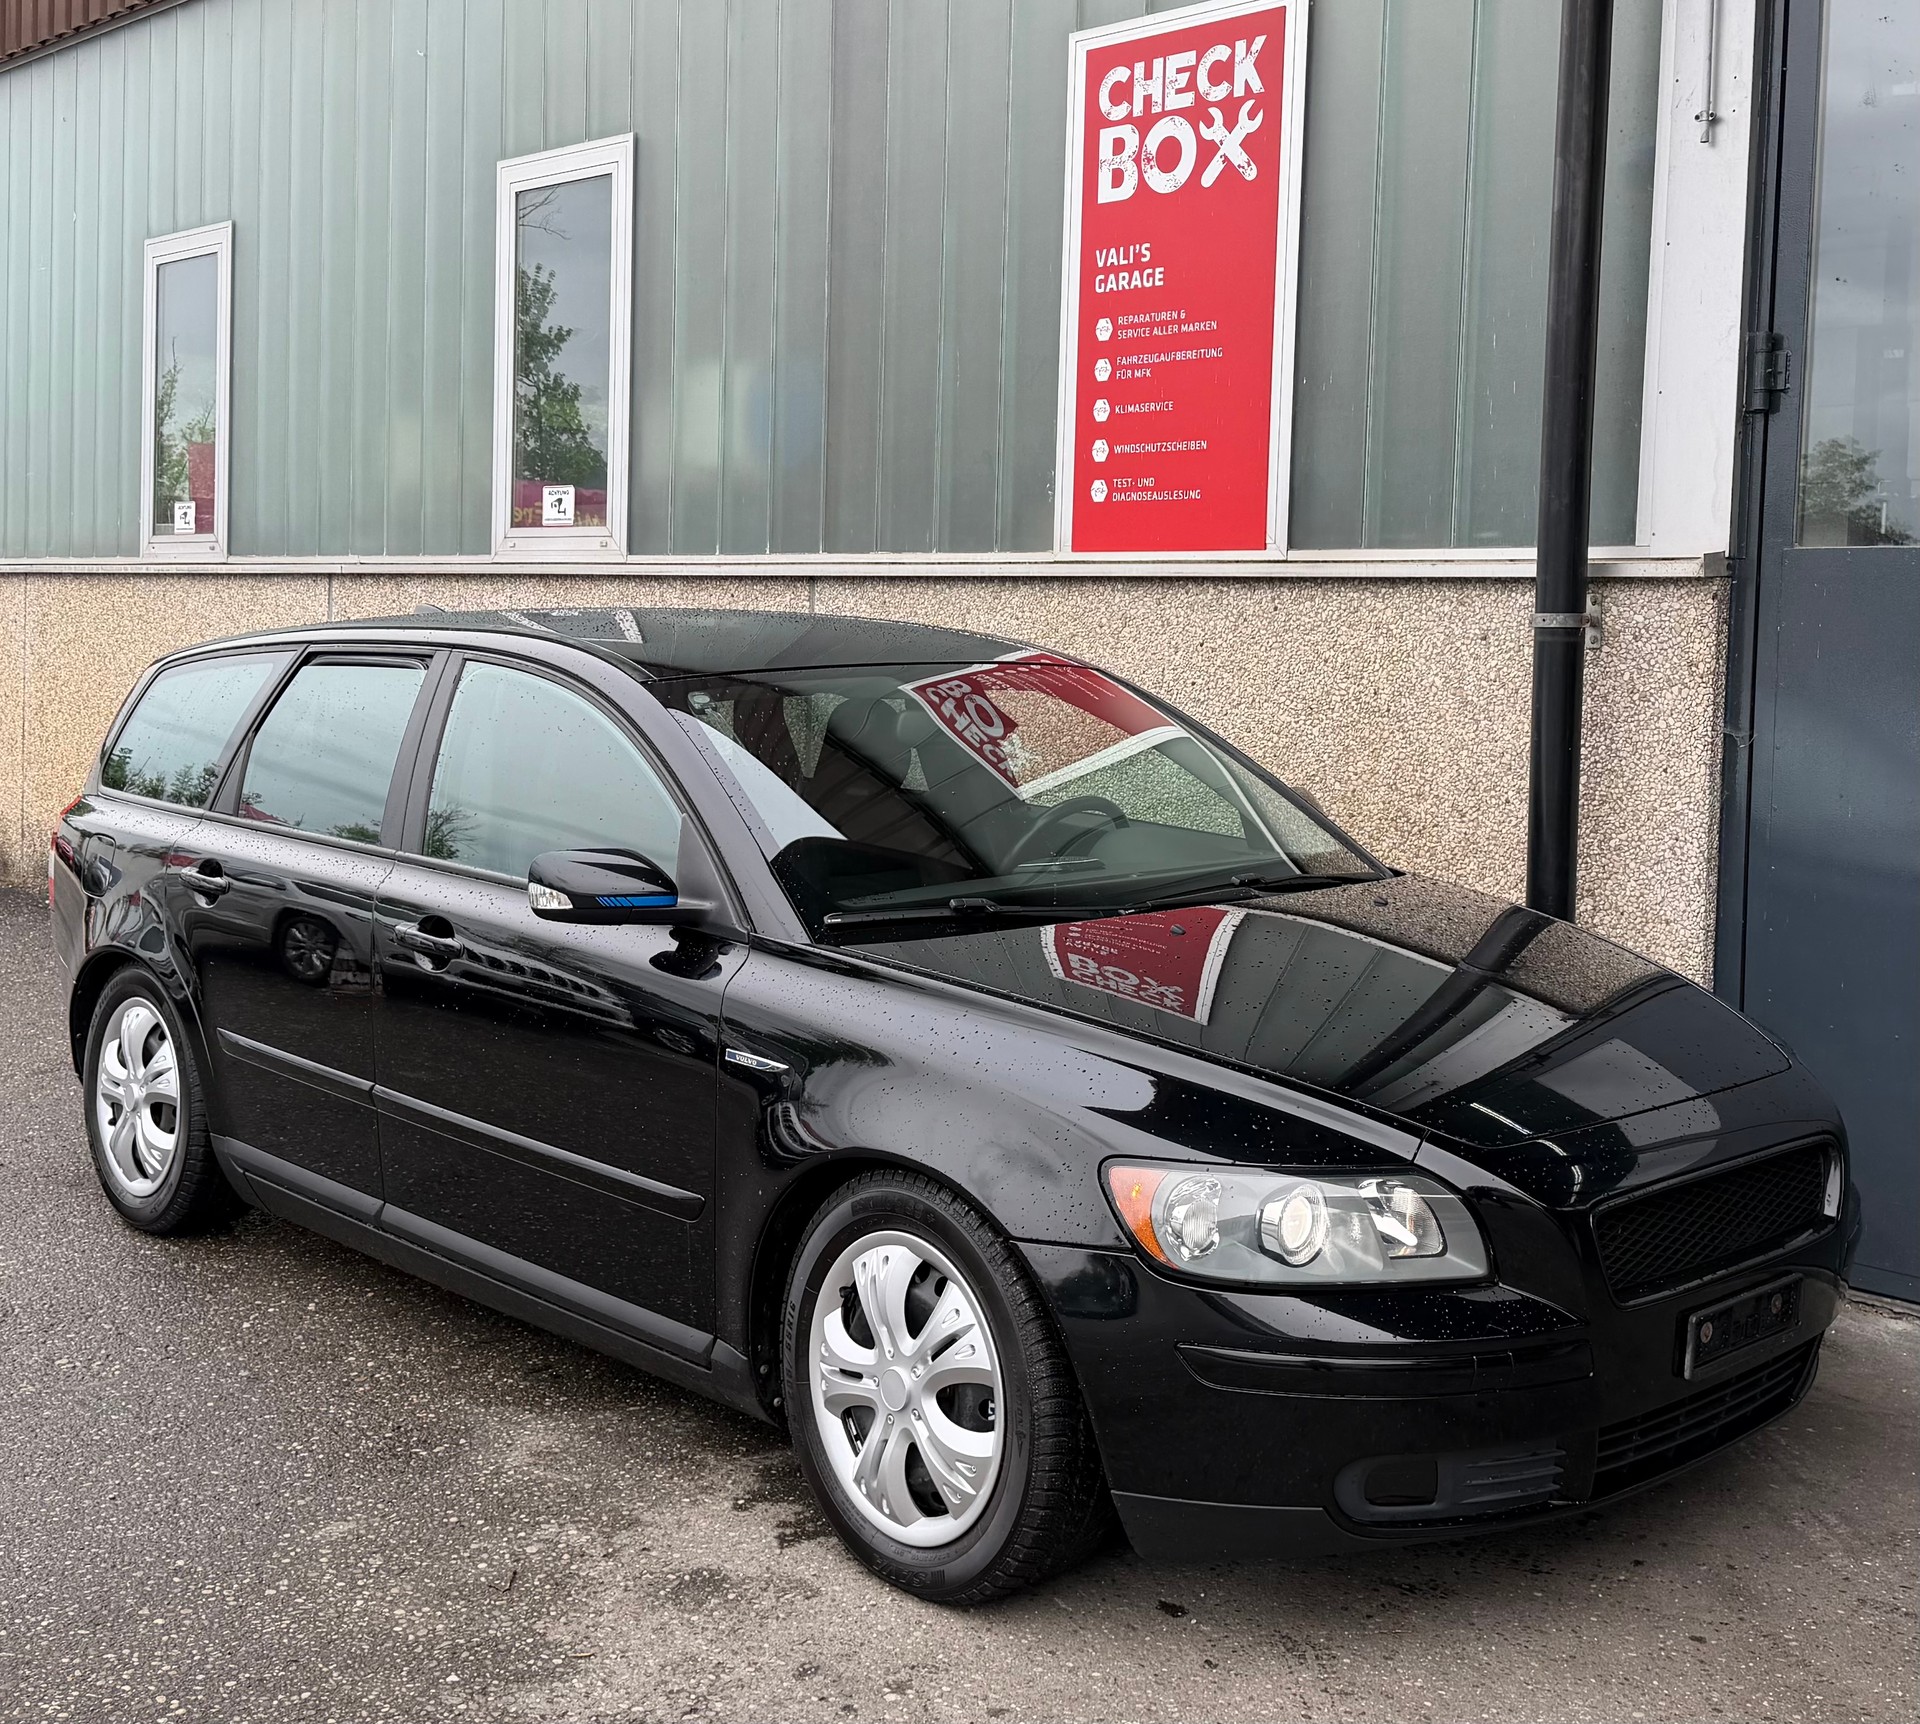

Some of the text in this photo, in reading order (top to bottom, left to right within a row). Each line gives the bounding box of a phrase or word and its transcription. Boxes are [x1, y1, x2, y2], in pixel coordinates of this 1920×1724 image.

[1098, 34, 1268, 122] CHECK
[1097, 98, 1264, 205] BOX
[1095, 242, 1151, 268] VALI'S
[1094, 266, 1165, 293] GARAGE
[1117, 309, 1186, 325] REPARATUREN &
[1117, 320, 1218, 340] SERVICE ALLER MARKEN
[1116, 347, 1223, 366] FAHRZEUGAUFBEREITUNG
[1116, 368, 1152, 380] FÜR MFK
[1114, 401, 1174, 414] KLIMASERVICE
[1113, 440, 1207, 454] WINDSCHUTZSCHEIBEN
[1112, 477, 1155, 488] TEST- UND
[1112, 490, 1201, 502] DIAGNOSEAUSLESUNG
[735, 1054, 757, 1066] VOLVO
